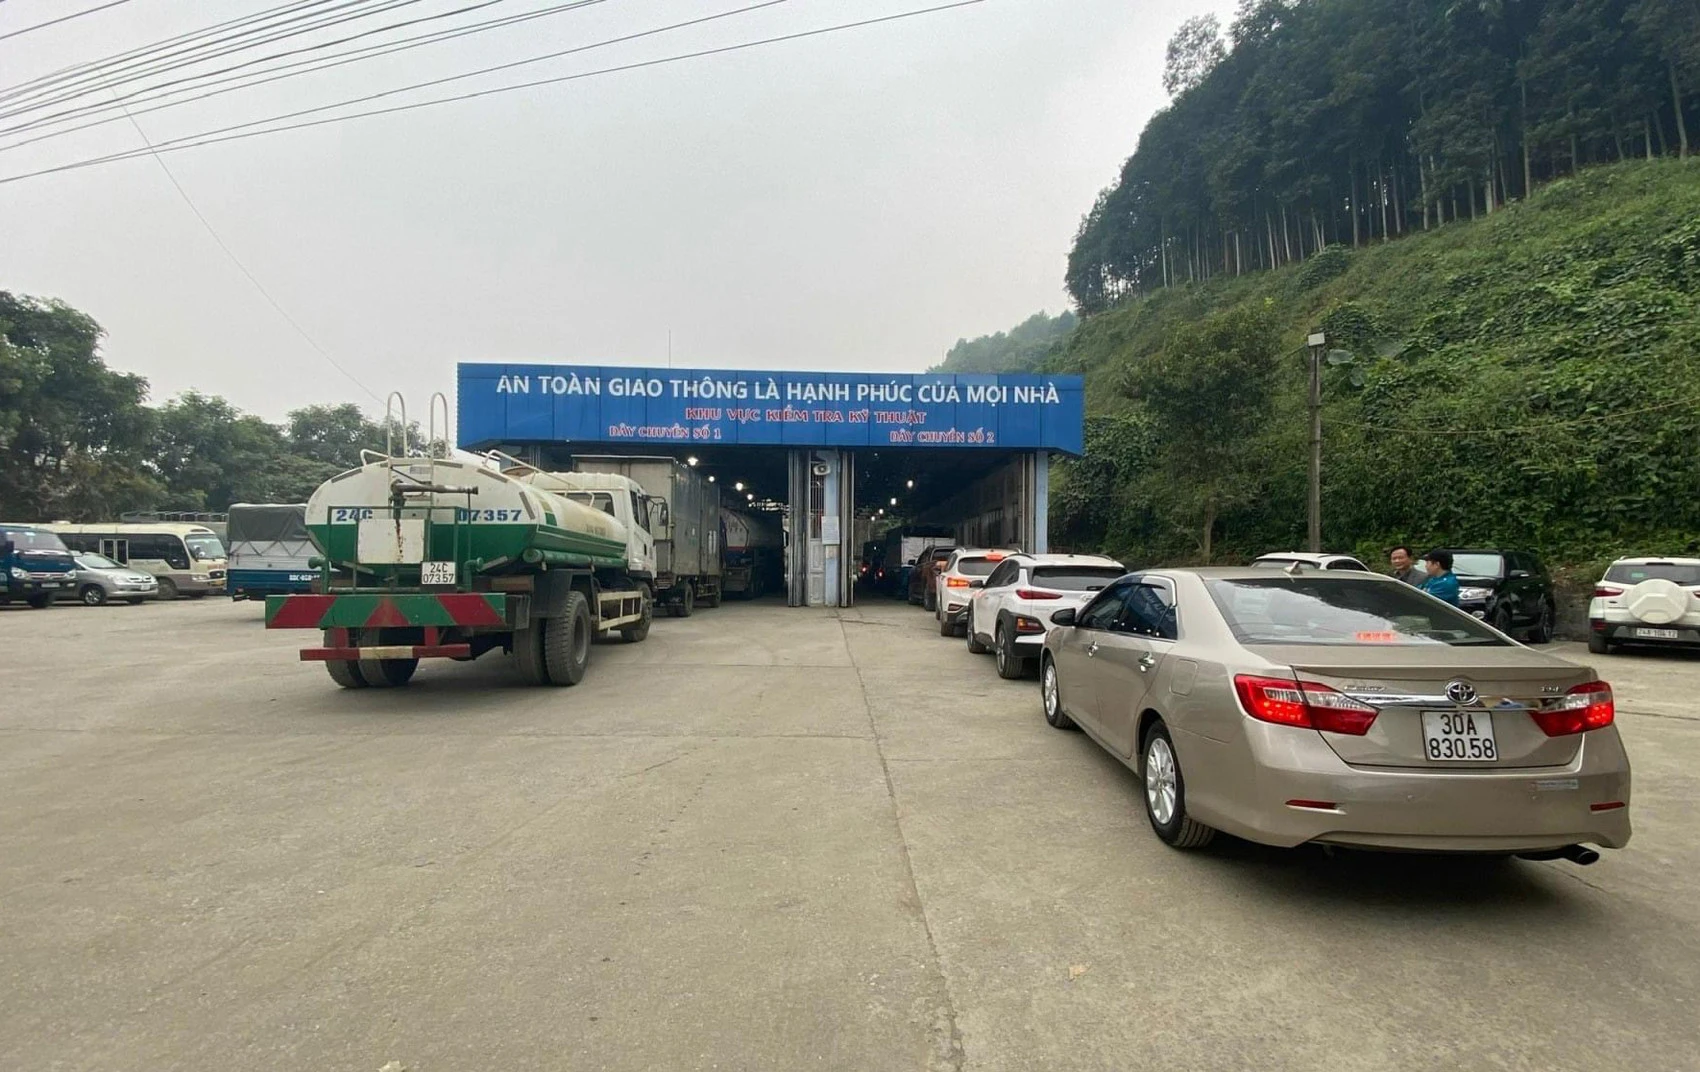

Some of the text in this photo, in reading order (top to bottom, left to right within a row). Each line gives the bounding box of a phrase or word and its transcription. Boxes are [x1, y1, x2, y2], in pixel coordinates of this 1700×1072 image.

[496, 371, 1060, 407] AN TOÀN GIAO THÔNG LÀ HẠNH PHÚC CỦA MỌI NHÀ
[685, 407, 721, 420] KHU
[726, 407, 761, 424] VỰC
[765, 404, 808, 422] KIỂM
[812, 410, 844, 422] TRA
[874, 409, 927, 426] THUẬT
[693, 424, 710, 439] SỐ
[714, 428, 722, 439] 1
[967, 427, 984, 443] SỐ
[986, 431, 995, 443] 2
[457, 509, 522, 522] 07357
[430, 562, 448, 573] 24C
[1440, 714, 1477, 735] 30A
[1429, 738, 1495, 759] 830.58
